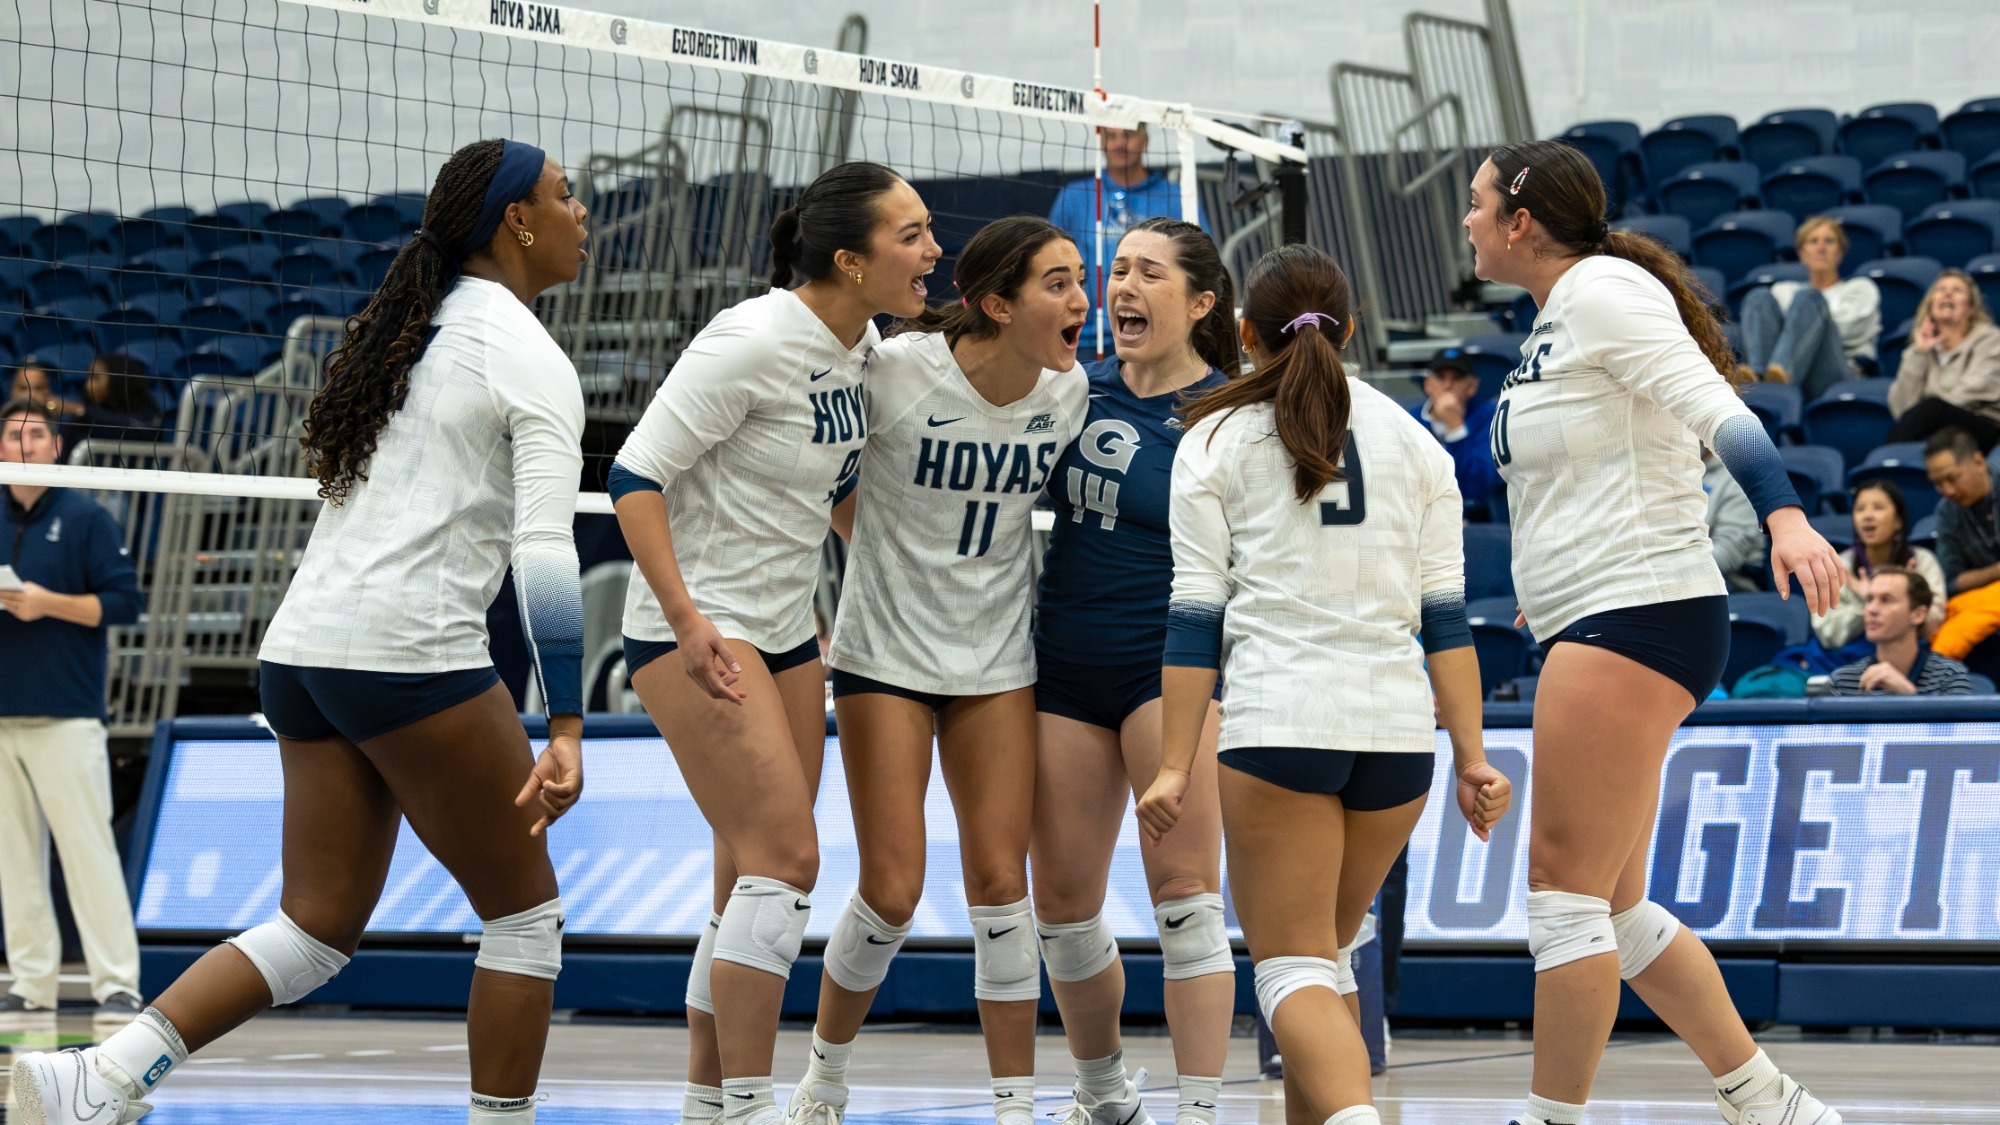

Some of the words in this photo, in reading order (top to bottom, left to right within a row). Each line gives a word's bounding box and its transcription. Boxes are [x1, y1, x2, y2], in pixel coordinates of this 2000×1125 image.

[490, 0, 524, 29] HOYA
[528, 5, 561, 35] SAXA
[610, 18, 628, 46] G
[671, 28, 758, 65] GEORGETOWN
[803, 49, 819, 75] G
[859, 57, 888, 86] HOYA
[890, 63, 919, 90] SAXA
[809, 382, 869, 444] HOY
[1026, 420, 1057, 430] EAST
[1031, 413, 1052, 422] BIG
[1079, 418, 1142, 475] G
[913, 437, 1057, 494] HOYAS
[1067, 465, 1120, 531] 14
[956, 499, 1000, 557] 11
[1425, 740, 2000, 932] OGET
[471, 1097, 497, 1108] NIKE
[499, 1097, 529, 1108] GRIP
